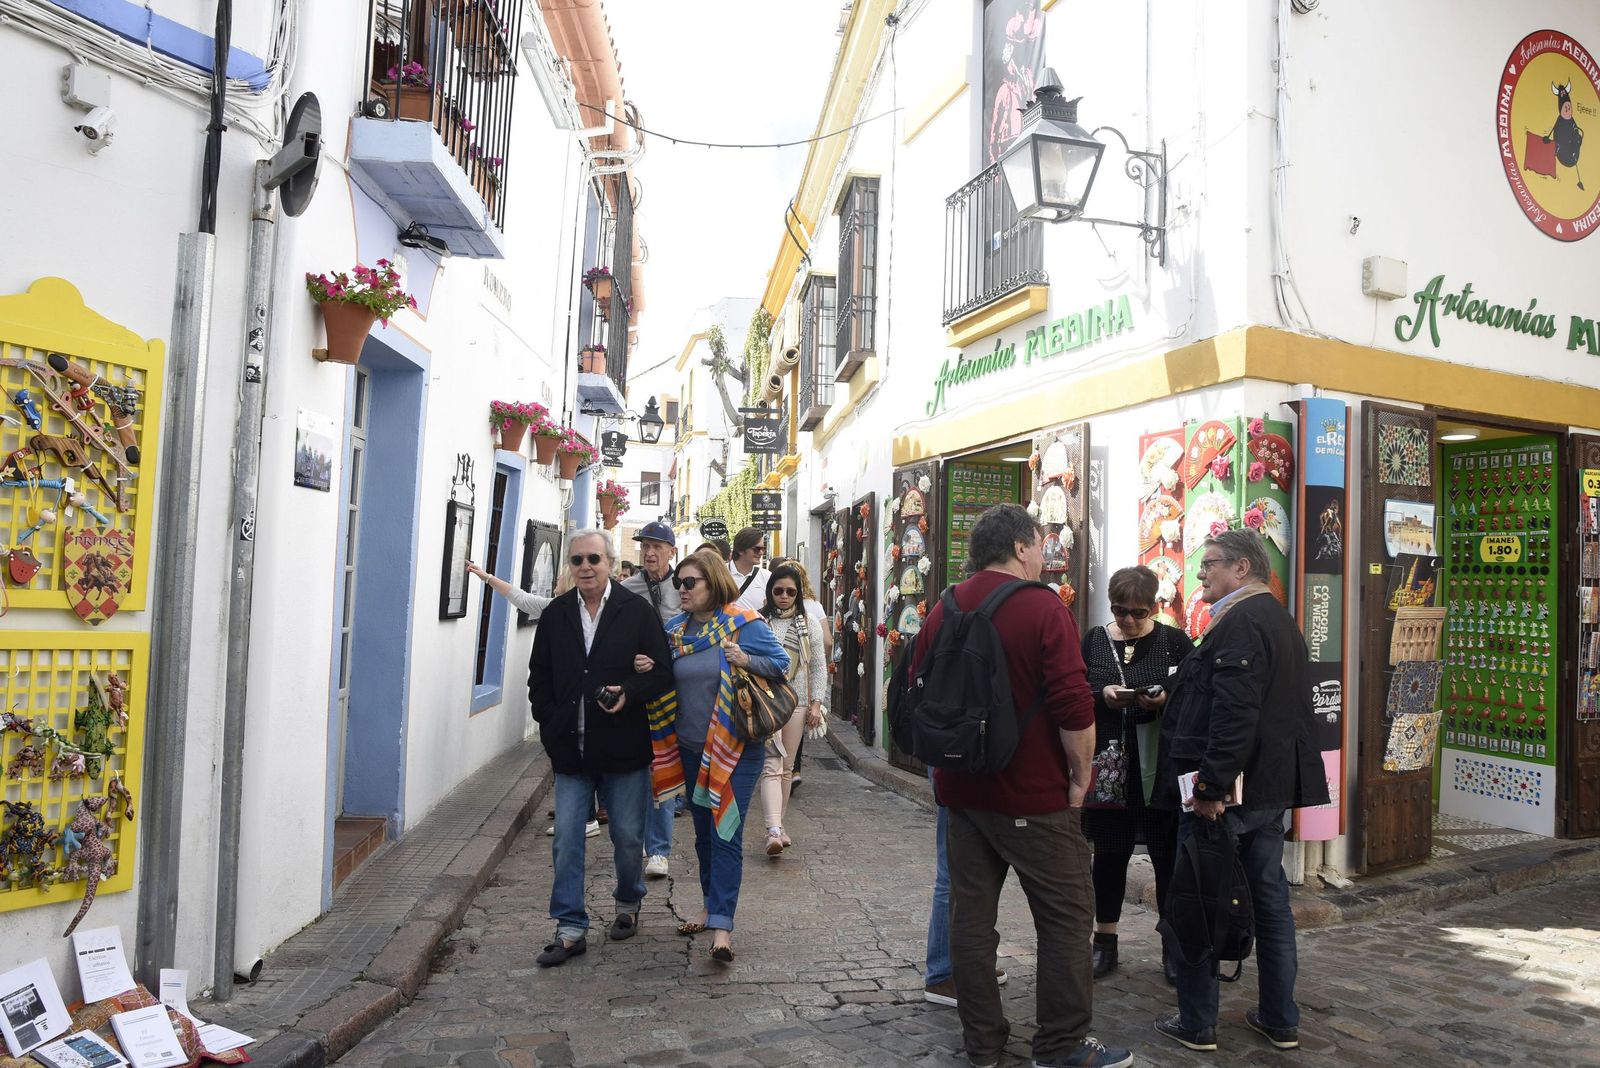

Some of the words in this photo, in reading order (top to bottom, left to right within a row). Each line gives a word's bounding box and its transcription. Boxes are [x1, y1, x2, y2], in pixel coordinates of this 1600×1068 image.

[1500, 84, 1513, 158] MEDINA
[483, 264, 512, 313] ROMERO
[1394, 274, 1557, 348] Artesanías
[1566, 315, 1600, 356] M
[926, 338, 1017, 417] Artesanías
[1023, 294, 1135, 366] MEDINA
[1316, 435, 1327, 444] EL
[1488, 545, 1512, 555] 1.80
[1313, 585, 1322, 600] LA
[1320, 585, 1331, 643] CÓRDOBA
